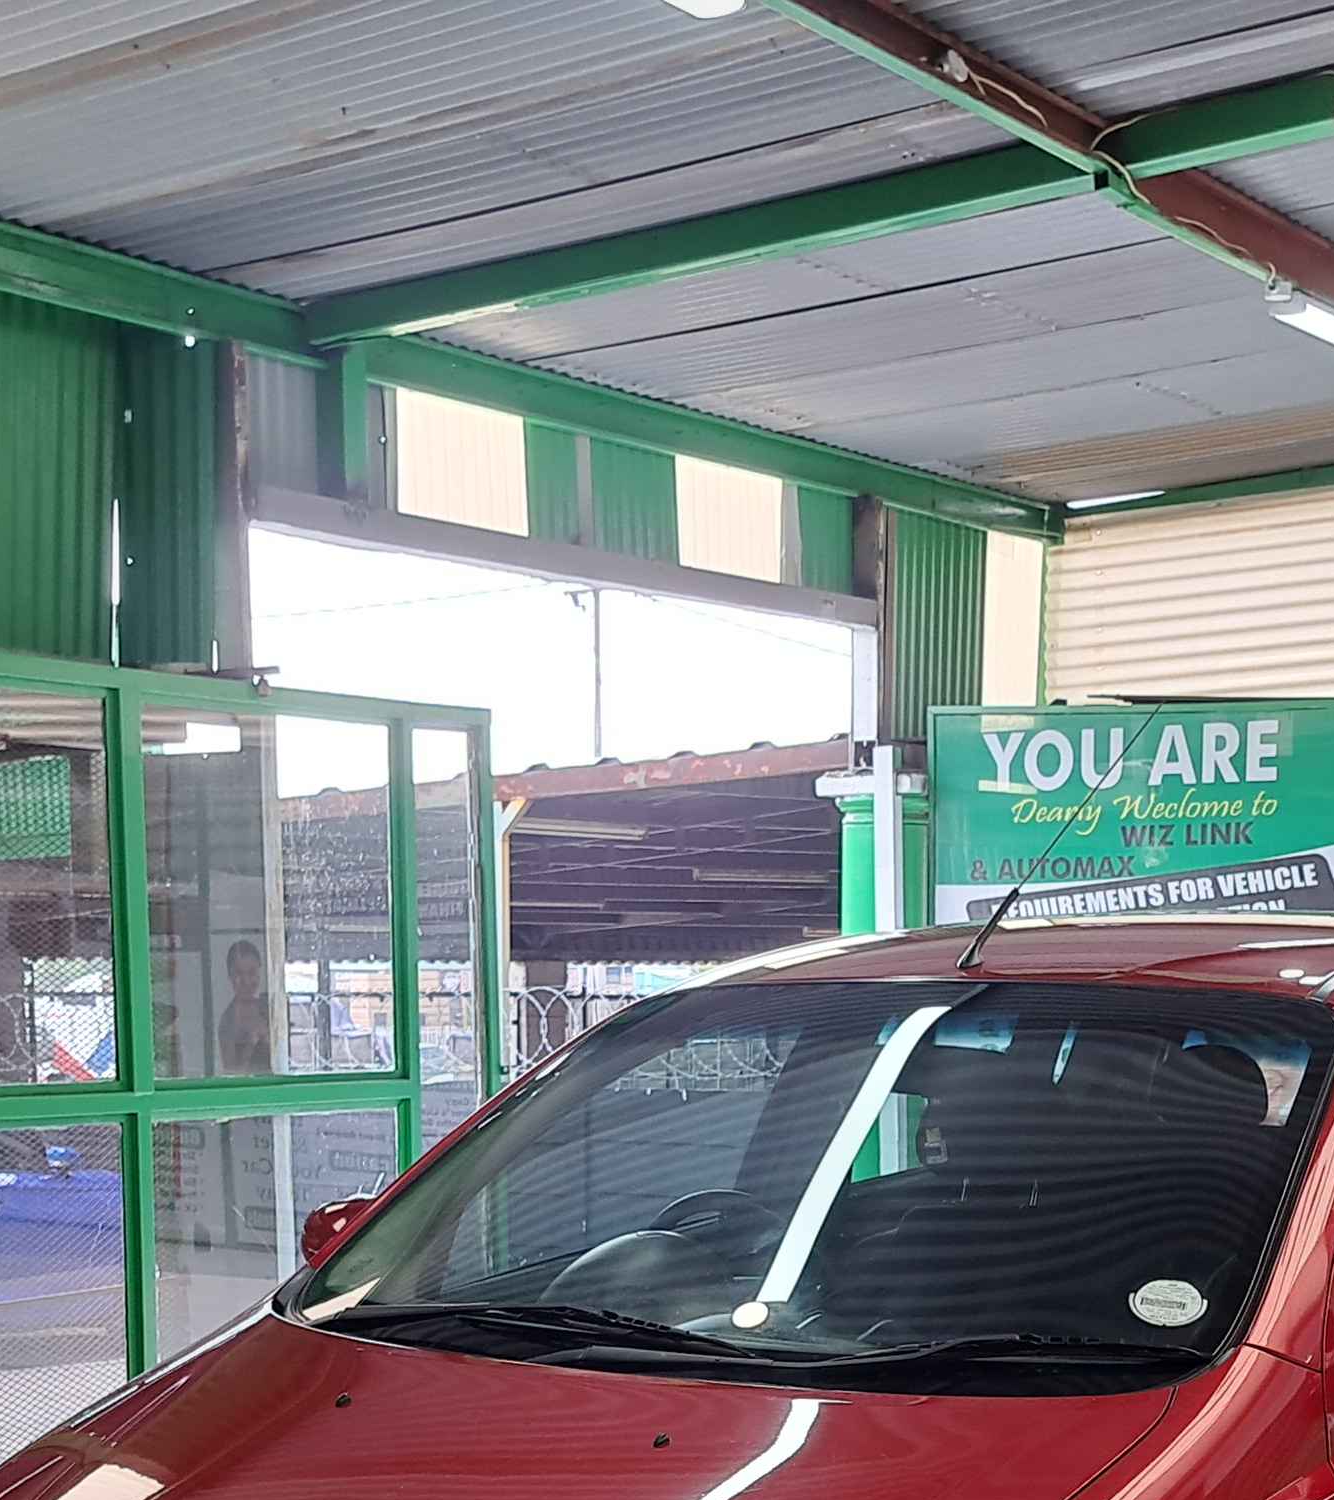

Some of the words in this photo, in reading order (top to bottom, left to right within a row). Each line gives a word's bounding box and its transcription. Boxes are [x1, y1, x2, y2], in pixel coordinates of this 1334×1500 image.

[983, 726, 1125, 792] YOU
[1147, 718, 1280, 787] ARE
[1113, 788, 1242, 820] Weclome
[1252, 790, 1278, 817] to
[1121, 823, 1175, 849] WIZ
[1185, 820, 1255, 847] LINK
[969, 858, 987, 882] &
[998, 854, 1137, 882] AUTOMAX
[1168, 875, 1215, 905] FOR
[1216, 862, 1319, 898] VEHICLE
